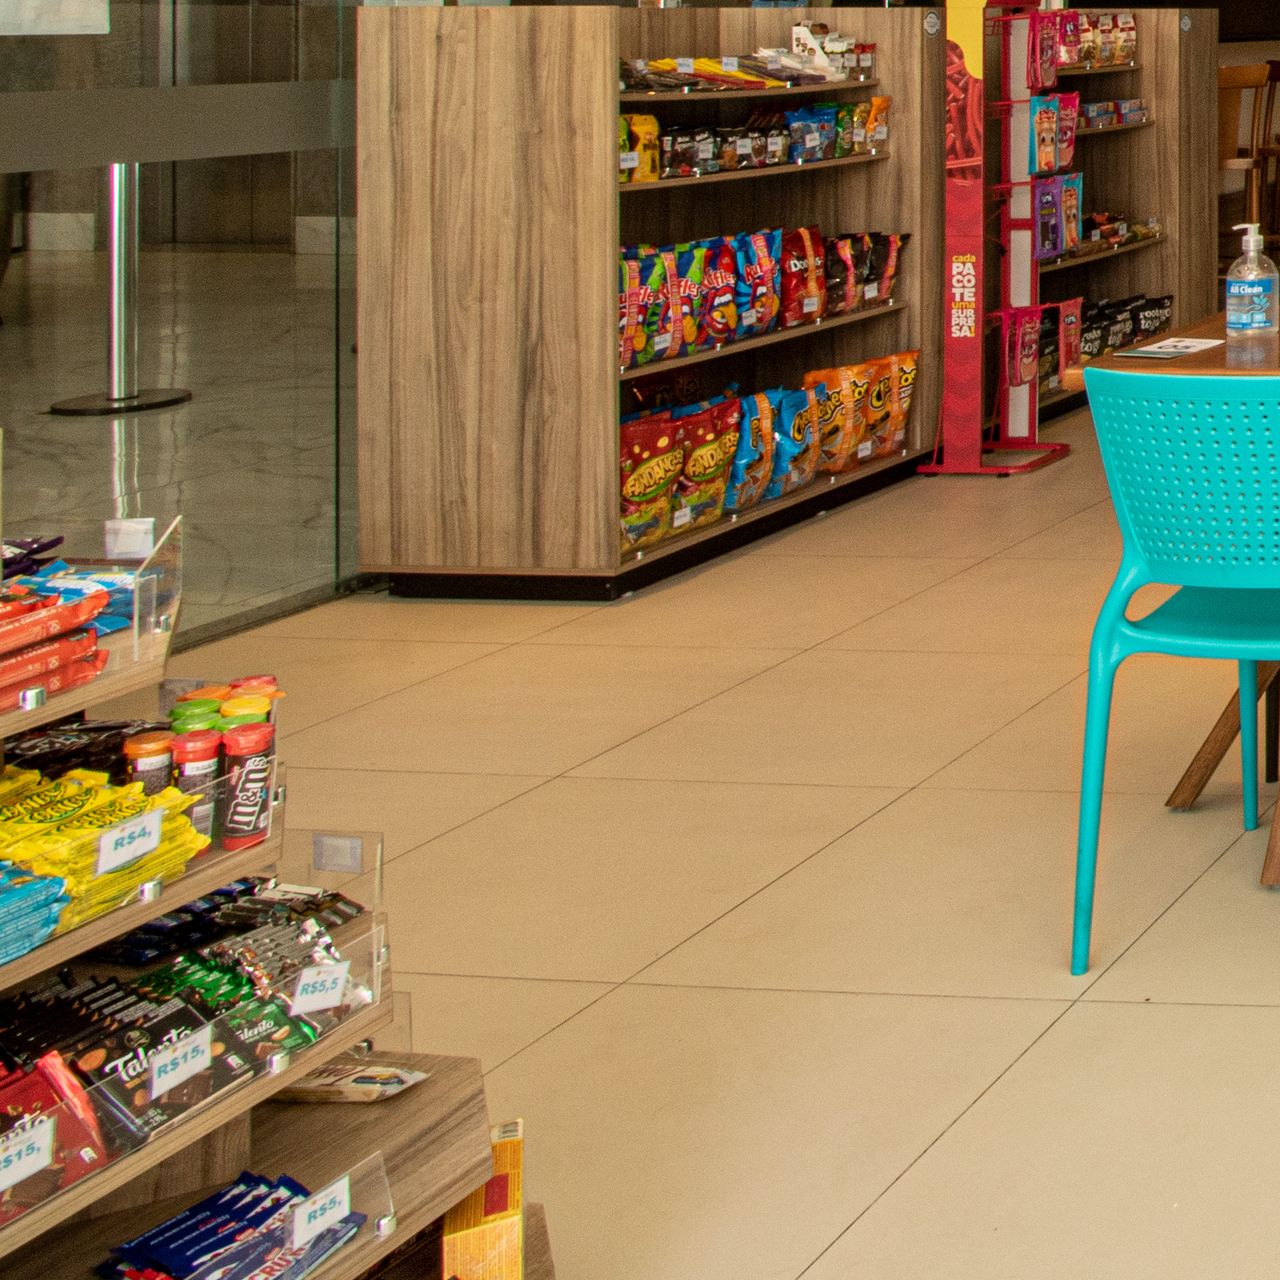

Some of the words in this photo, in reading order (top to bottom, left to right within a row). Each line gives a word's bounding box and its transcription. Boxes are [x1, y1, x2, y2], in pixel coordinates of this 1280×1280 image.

[952, 253, 977, 262] cada
[952, 263, 976, 275] PA
[952, 275, 976, 287] CO
[952, 288, 976, 301] TE
[1230, 285, 1239, 293] All
[1239, 285, 1263, 294] Clean
[952, 309, 975, 318] SUR
[952, 318, 975, 326] PRE
[951, 326, 975, 337] SA!
[0, 1141, 42, 1170] $15,
